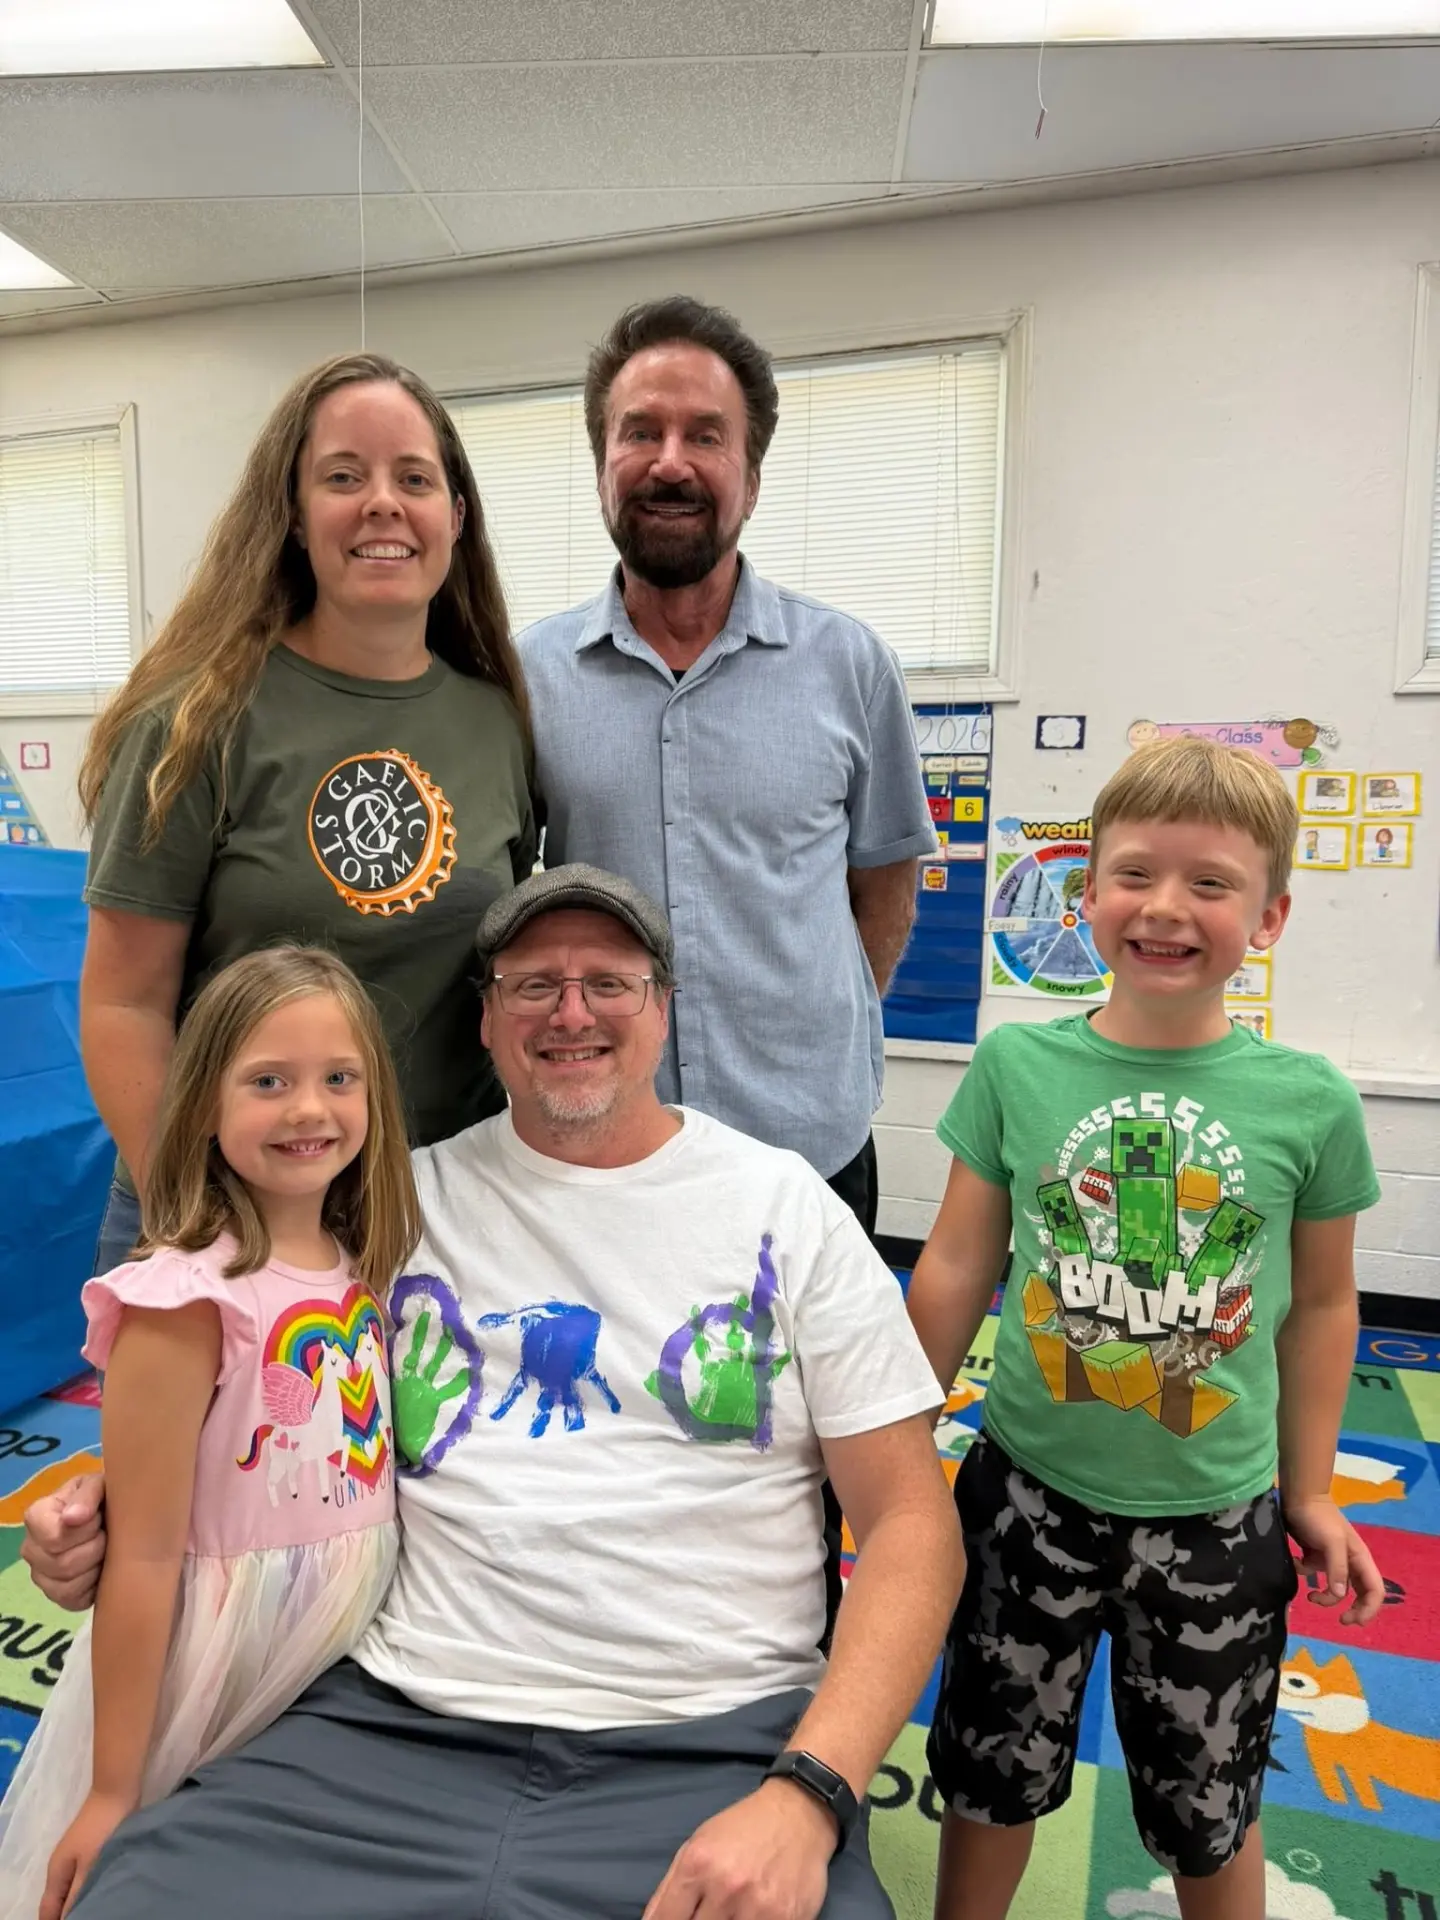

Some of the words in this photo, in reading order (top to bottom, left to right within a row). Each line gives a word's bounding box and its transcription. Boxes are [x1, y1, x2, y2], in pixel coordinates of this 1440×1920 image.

[1216, 728, 1264, 745] Class
[327, 762, 428, 841] GAELIC
[932, 802, 943, 817] 5
[964, 801, 975, 817] 6
[315, 814, 416, 889] STORM
[1052, 844, 1089, 857] windy
[1000, 872, 1018, 900] rainy
[1047, 983, 1085, 995] snowy
[1088, 1177, 1108, 1189] TNT
[1057, 1253, 1221, 1340] BOOM
